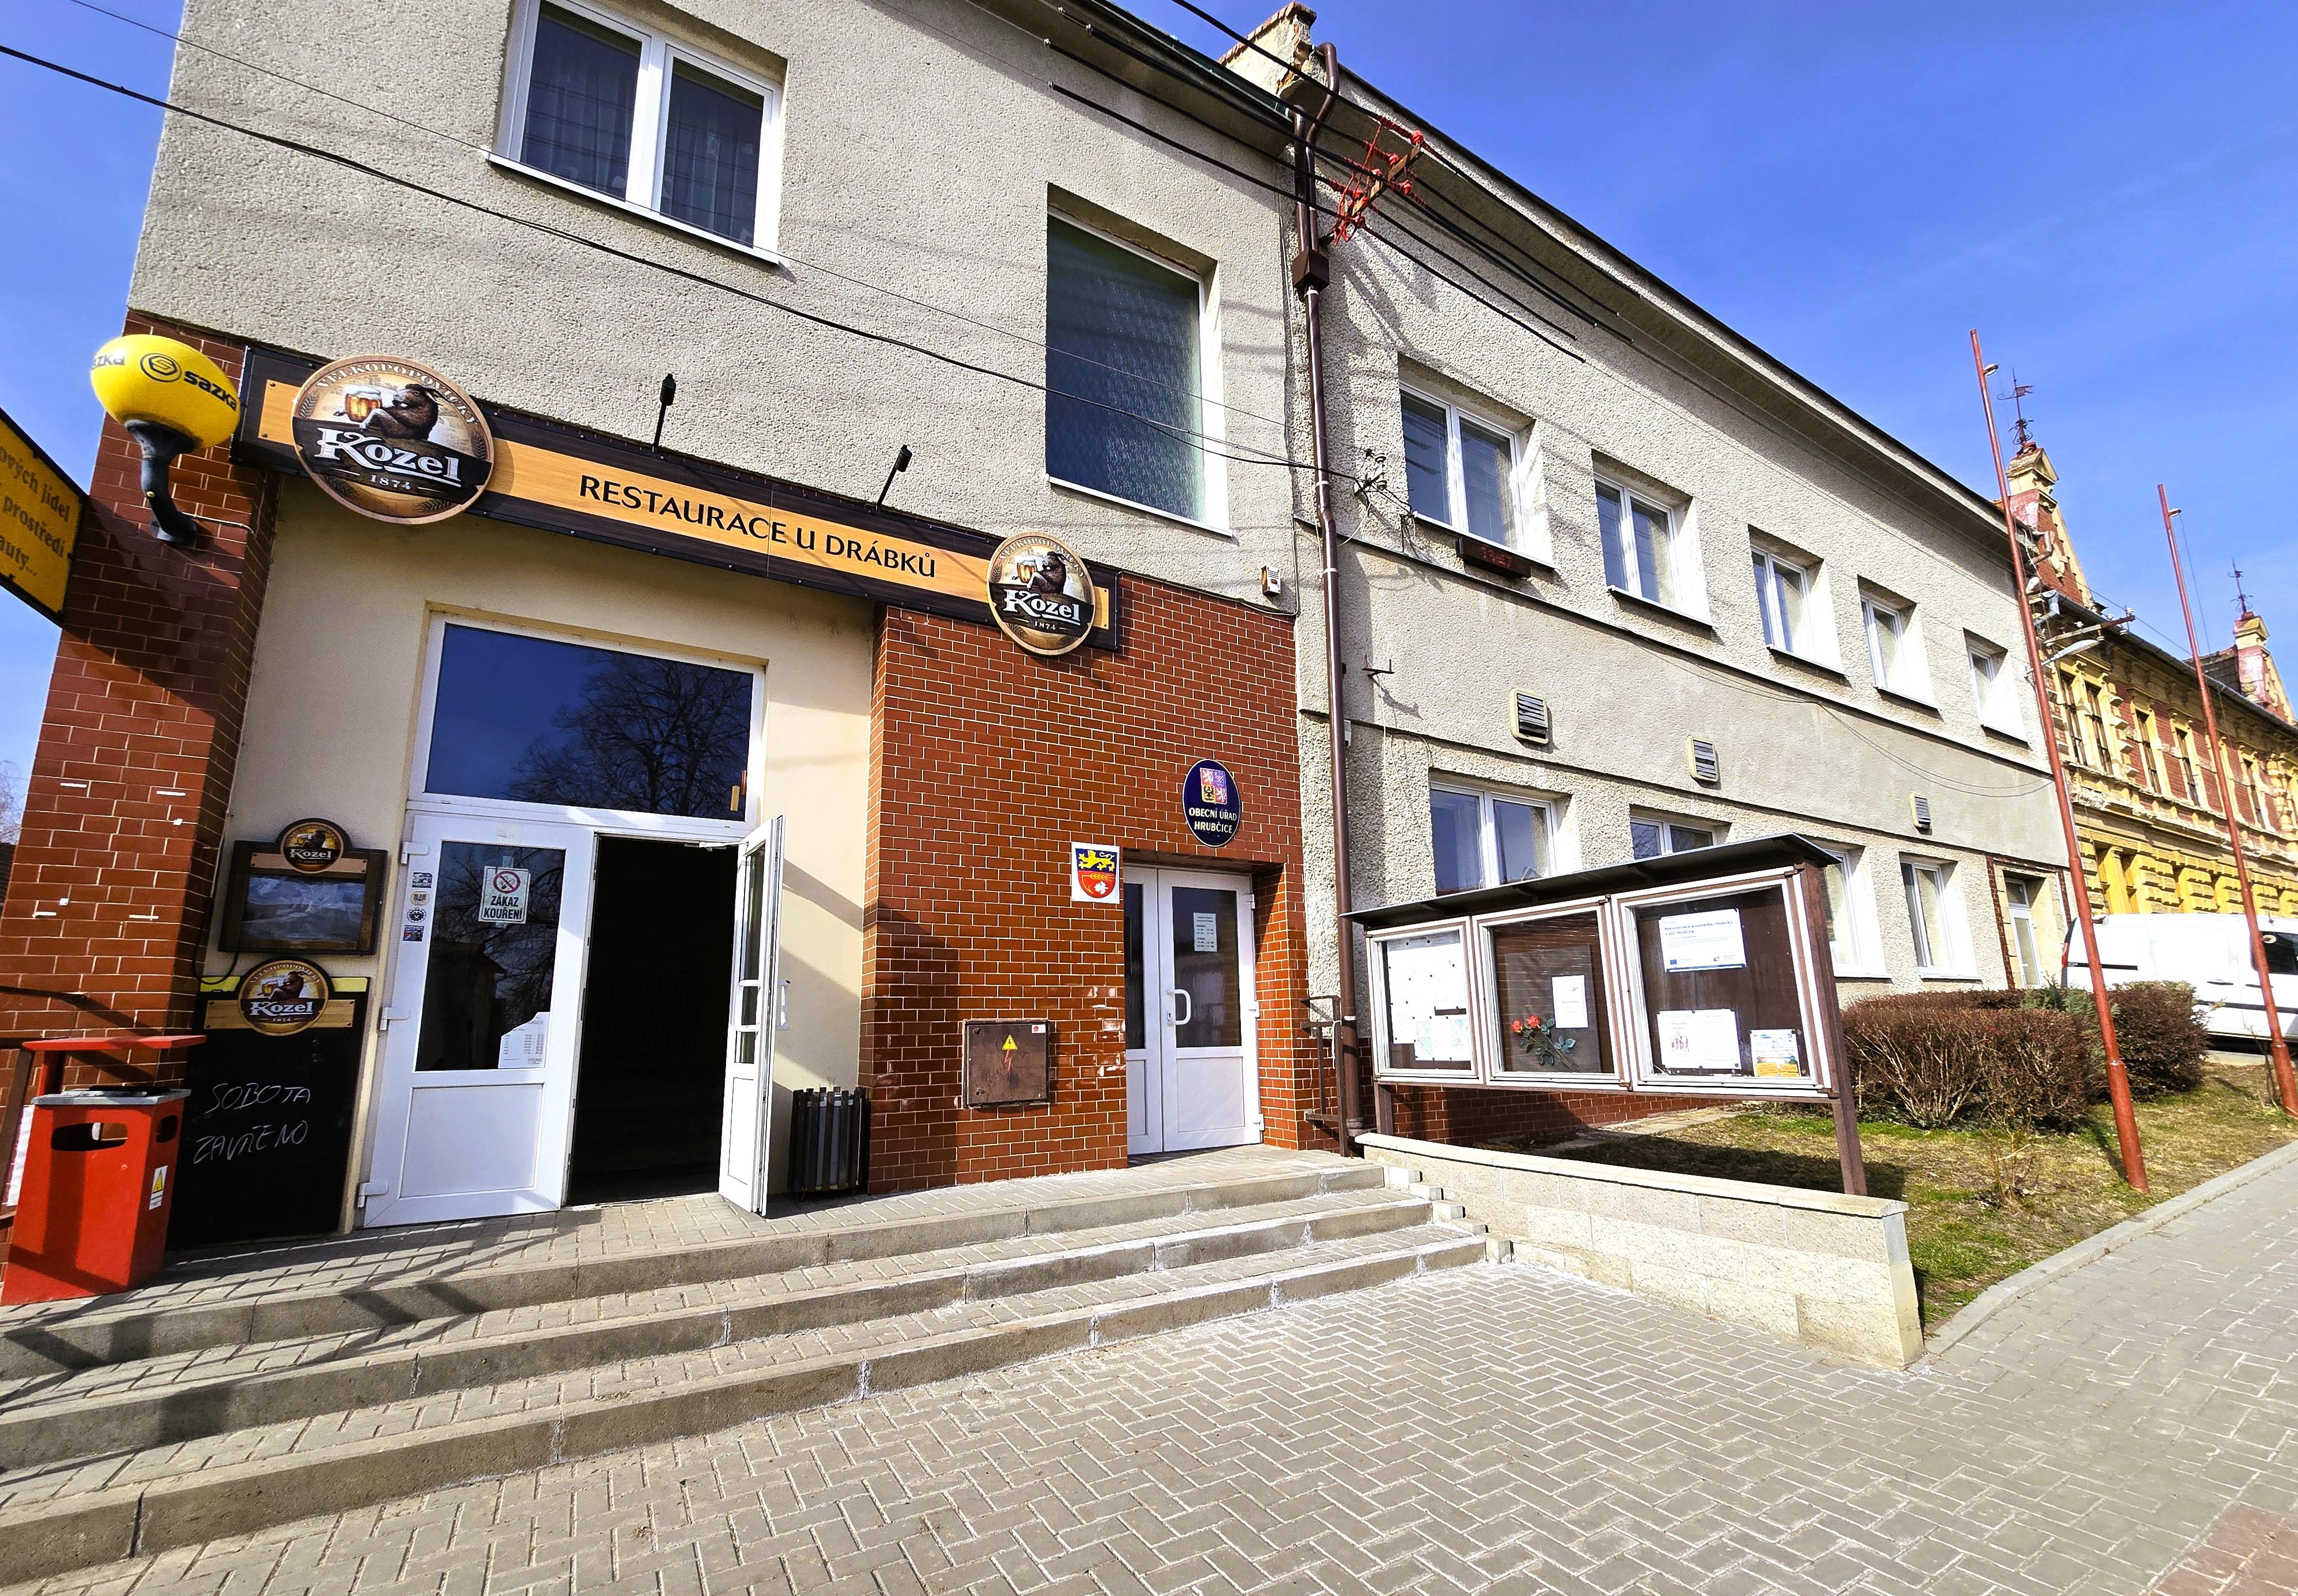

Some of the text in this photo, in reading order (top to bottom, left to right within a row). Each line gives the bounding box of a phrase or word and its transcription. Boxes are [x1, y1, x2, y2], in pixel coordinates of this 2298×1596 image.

[314, 427, 461, 483] Kozel
[371, 475, 412, 490] 1874
[580, 475, 936, 578] RESTAURACE U DRÁBKŮ
[1003, 589, 1081, 622] Kozel
[1035, 622, 1056, 630] 1874
[1189, 807, 1237, 821] OBECNÍ ÚŘAD
[1194, 821, 1233, 834] HRUBČICE
[290, 849, 331, 859] Kozel
[491, 894, 519, 907] ZÁKAZ
[483, 907, 523, 920] KOUŘENÍ
[249, 1001, 313, 1016] Kozel
[203, 1082, 311, 1115] SOBOTA
